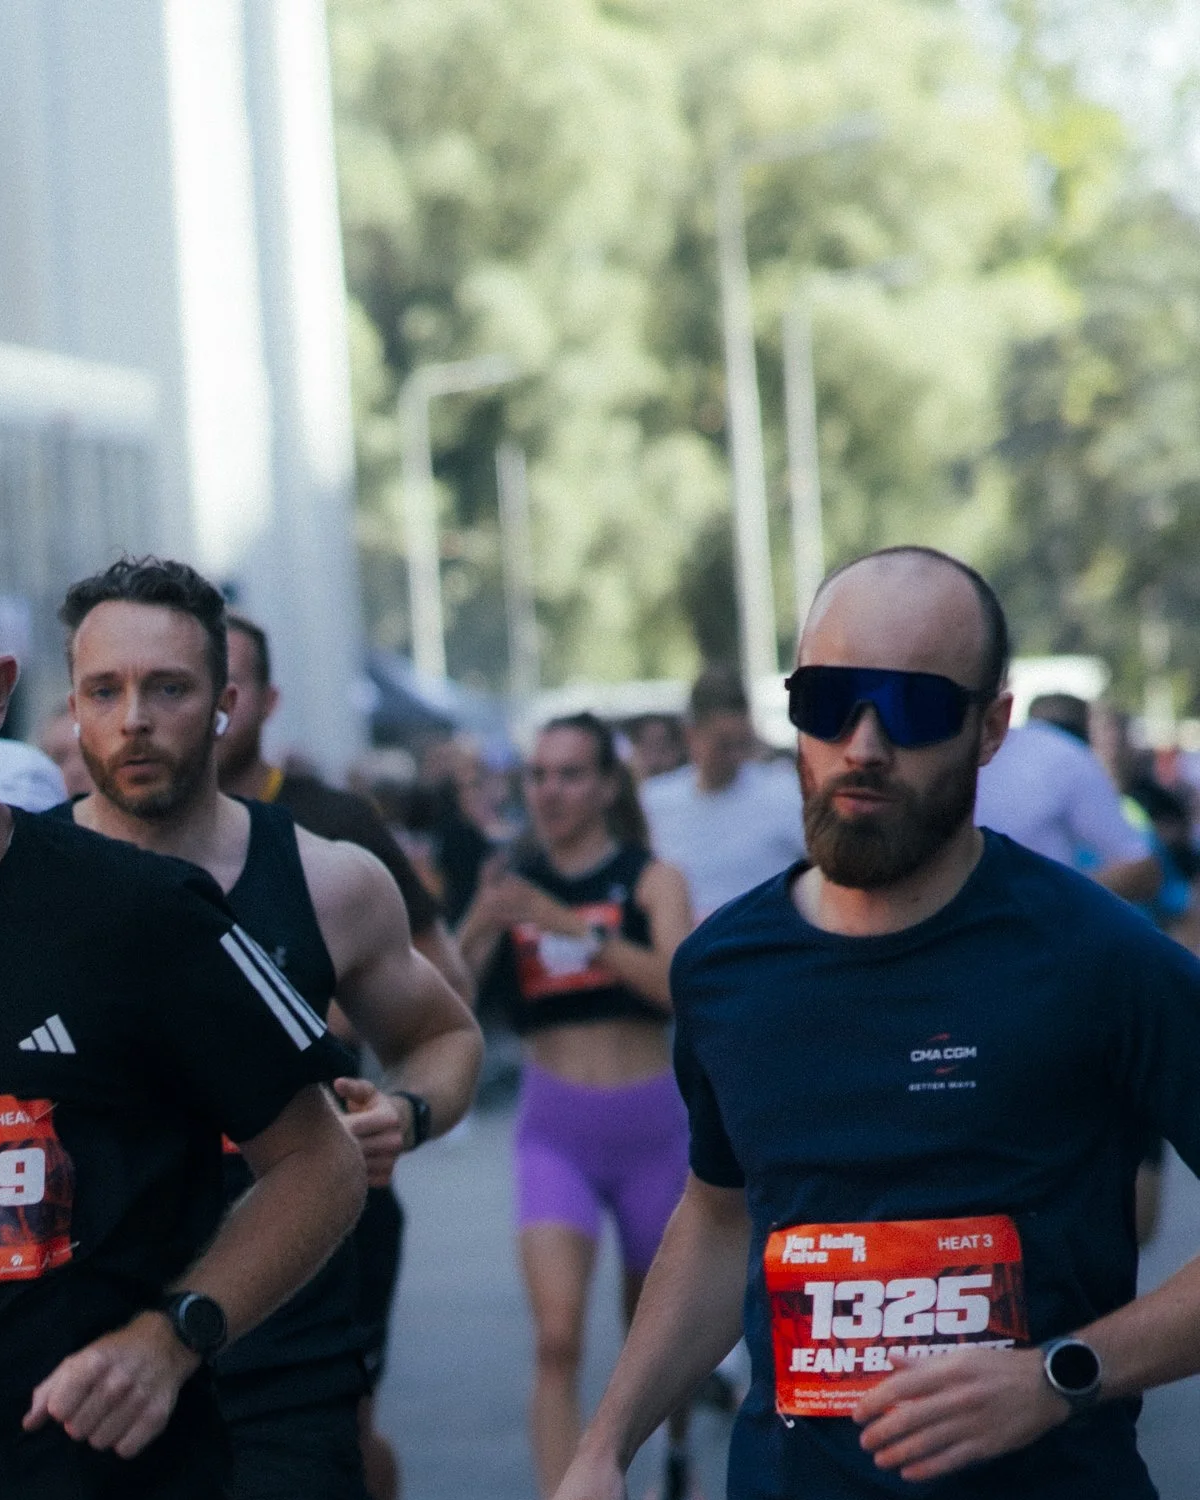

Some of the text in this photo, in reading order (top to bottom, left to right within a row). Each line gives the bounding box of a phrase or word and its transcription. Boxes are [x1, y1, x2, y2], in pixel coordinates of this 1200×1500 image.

[910, 1046, 977, 1062] CMA CGM
[938, 1233, 993, 1251] HEAT 3
[804, 1273, 992, 1340] 1325
